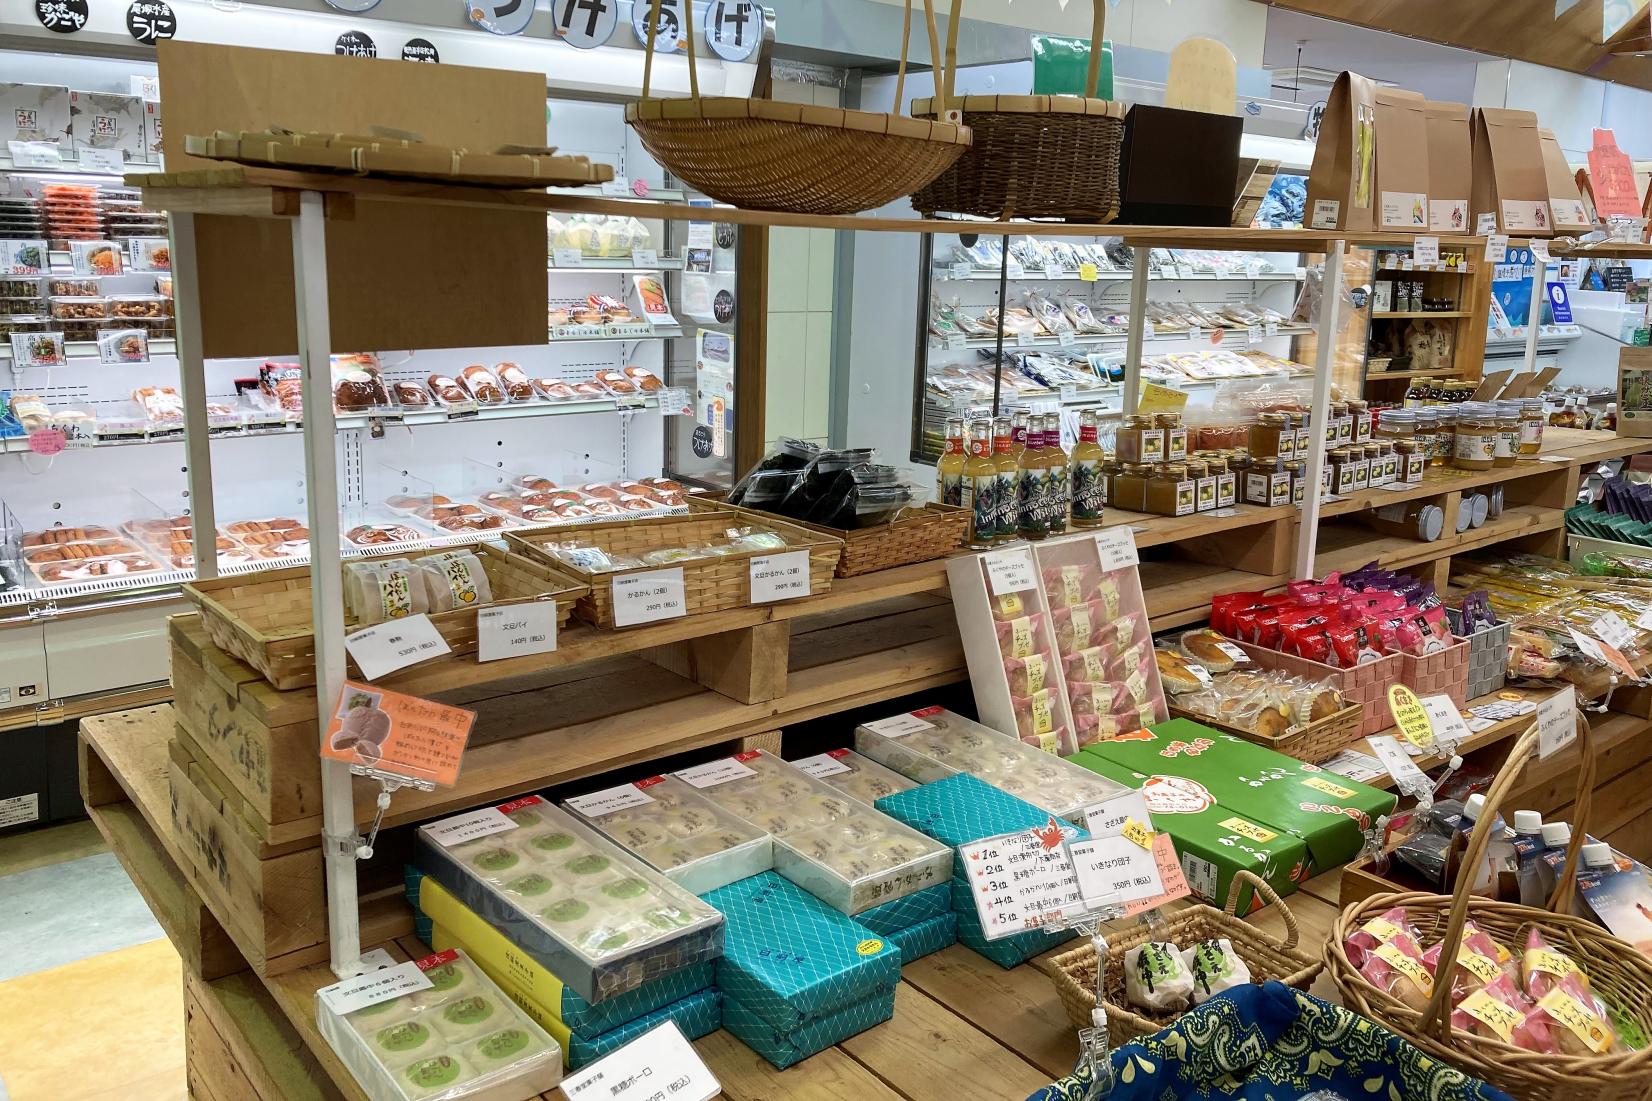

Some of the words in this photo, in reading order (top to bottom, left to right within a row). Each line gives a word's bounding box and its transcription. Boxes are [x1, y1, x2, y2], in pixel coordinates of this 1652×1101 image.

[133, 16, 172, 40] うに
[627, 586, 668, 599] かるかん（2個）
[985, 864, 1004, 875] 2位
[1091, 856, 1132, 871] いきなり団子
[989, 881, 1008, 892] 3位
[1112, 875, 1152, 890] 350円（税込）
[994, 895, 1014, 907] 4位
[999, 912, 1019, 924] 5位
[609, 1066, 653, 1097] 黒糖ボーロ
